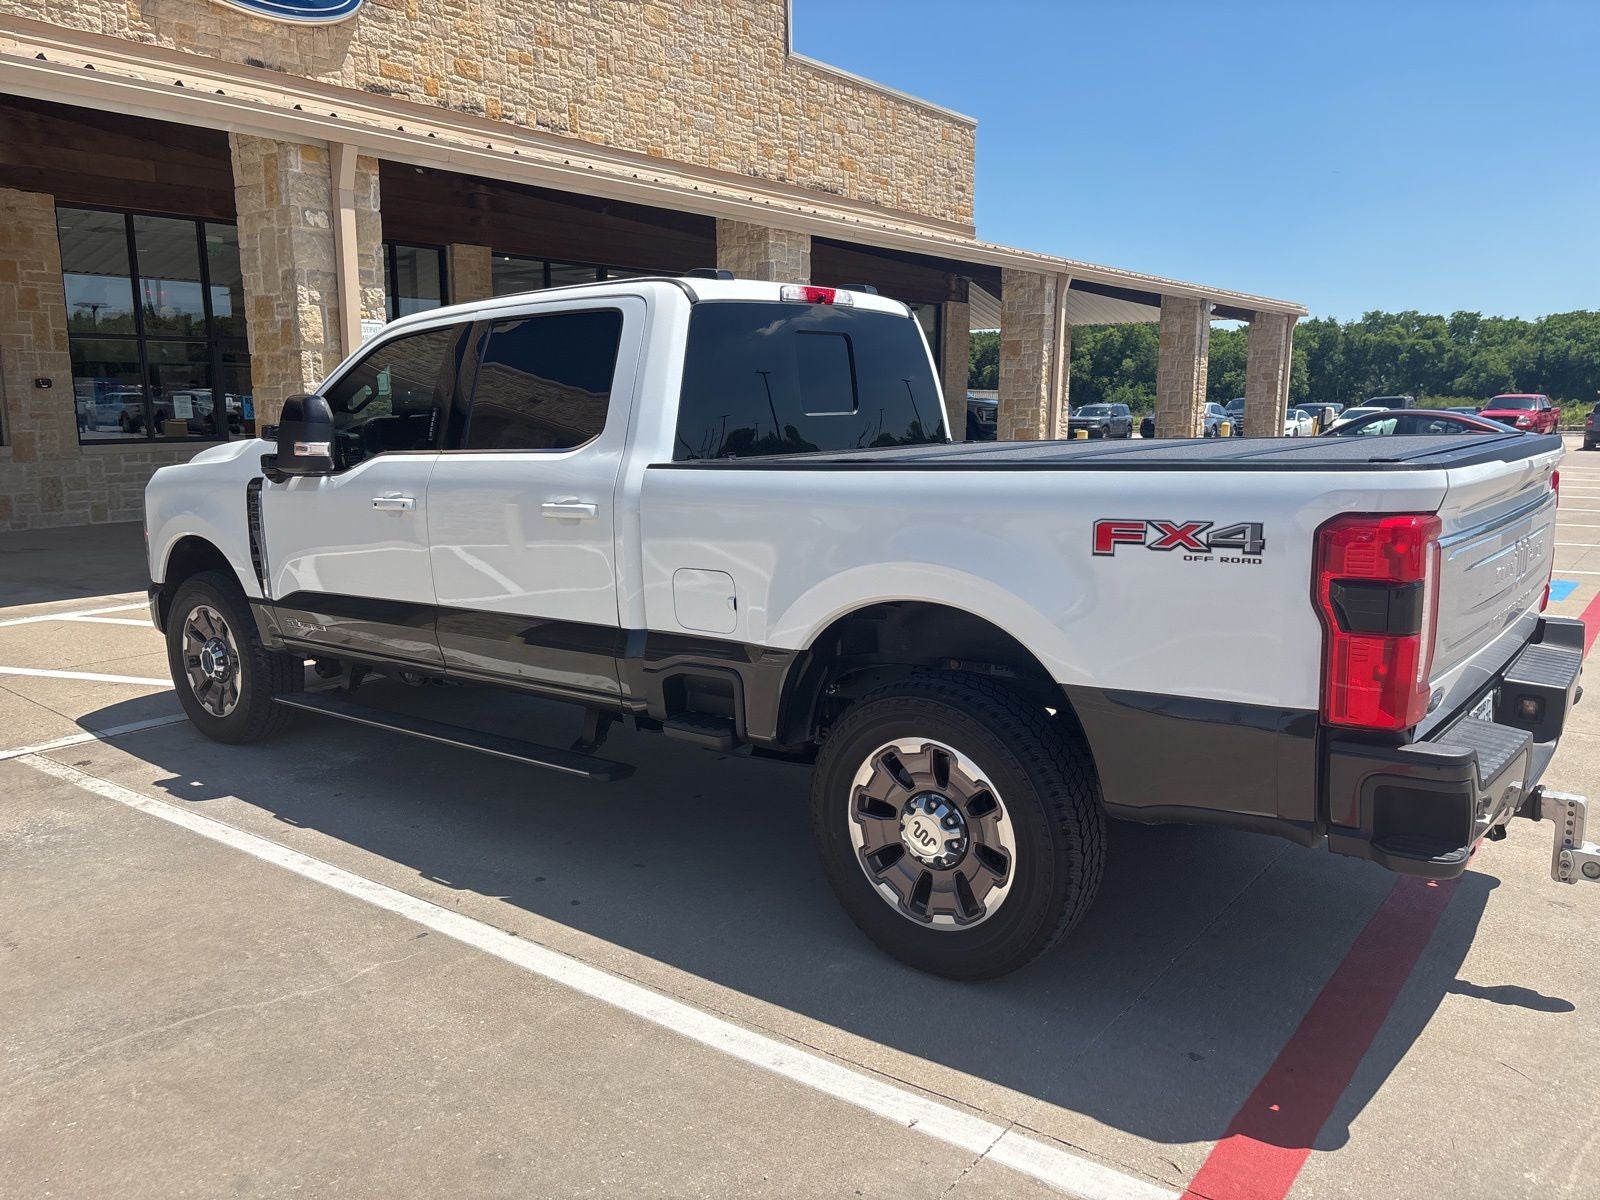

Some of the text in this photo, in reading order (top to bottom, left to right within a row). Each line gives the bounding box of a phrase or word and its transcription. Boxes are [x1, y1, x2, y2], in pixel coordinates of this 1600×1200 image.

[1092, 518, 1266, 557] FX4
[1183, 554, 1263, 565] OFF ROAD
